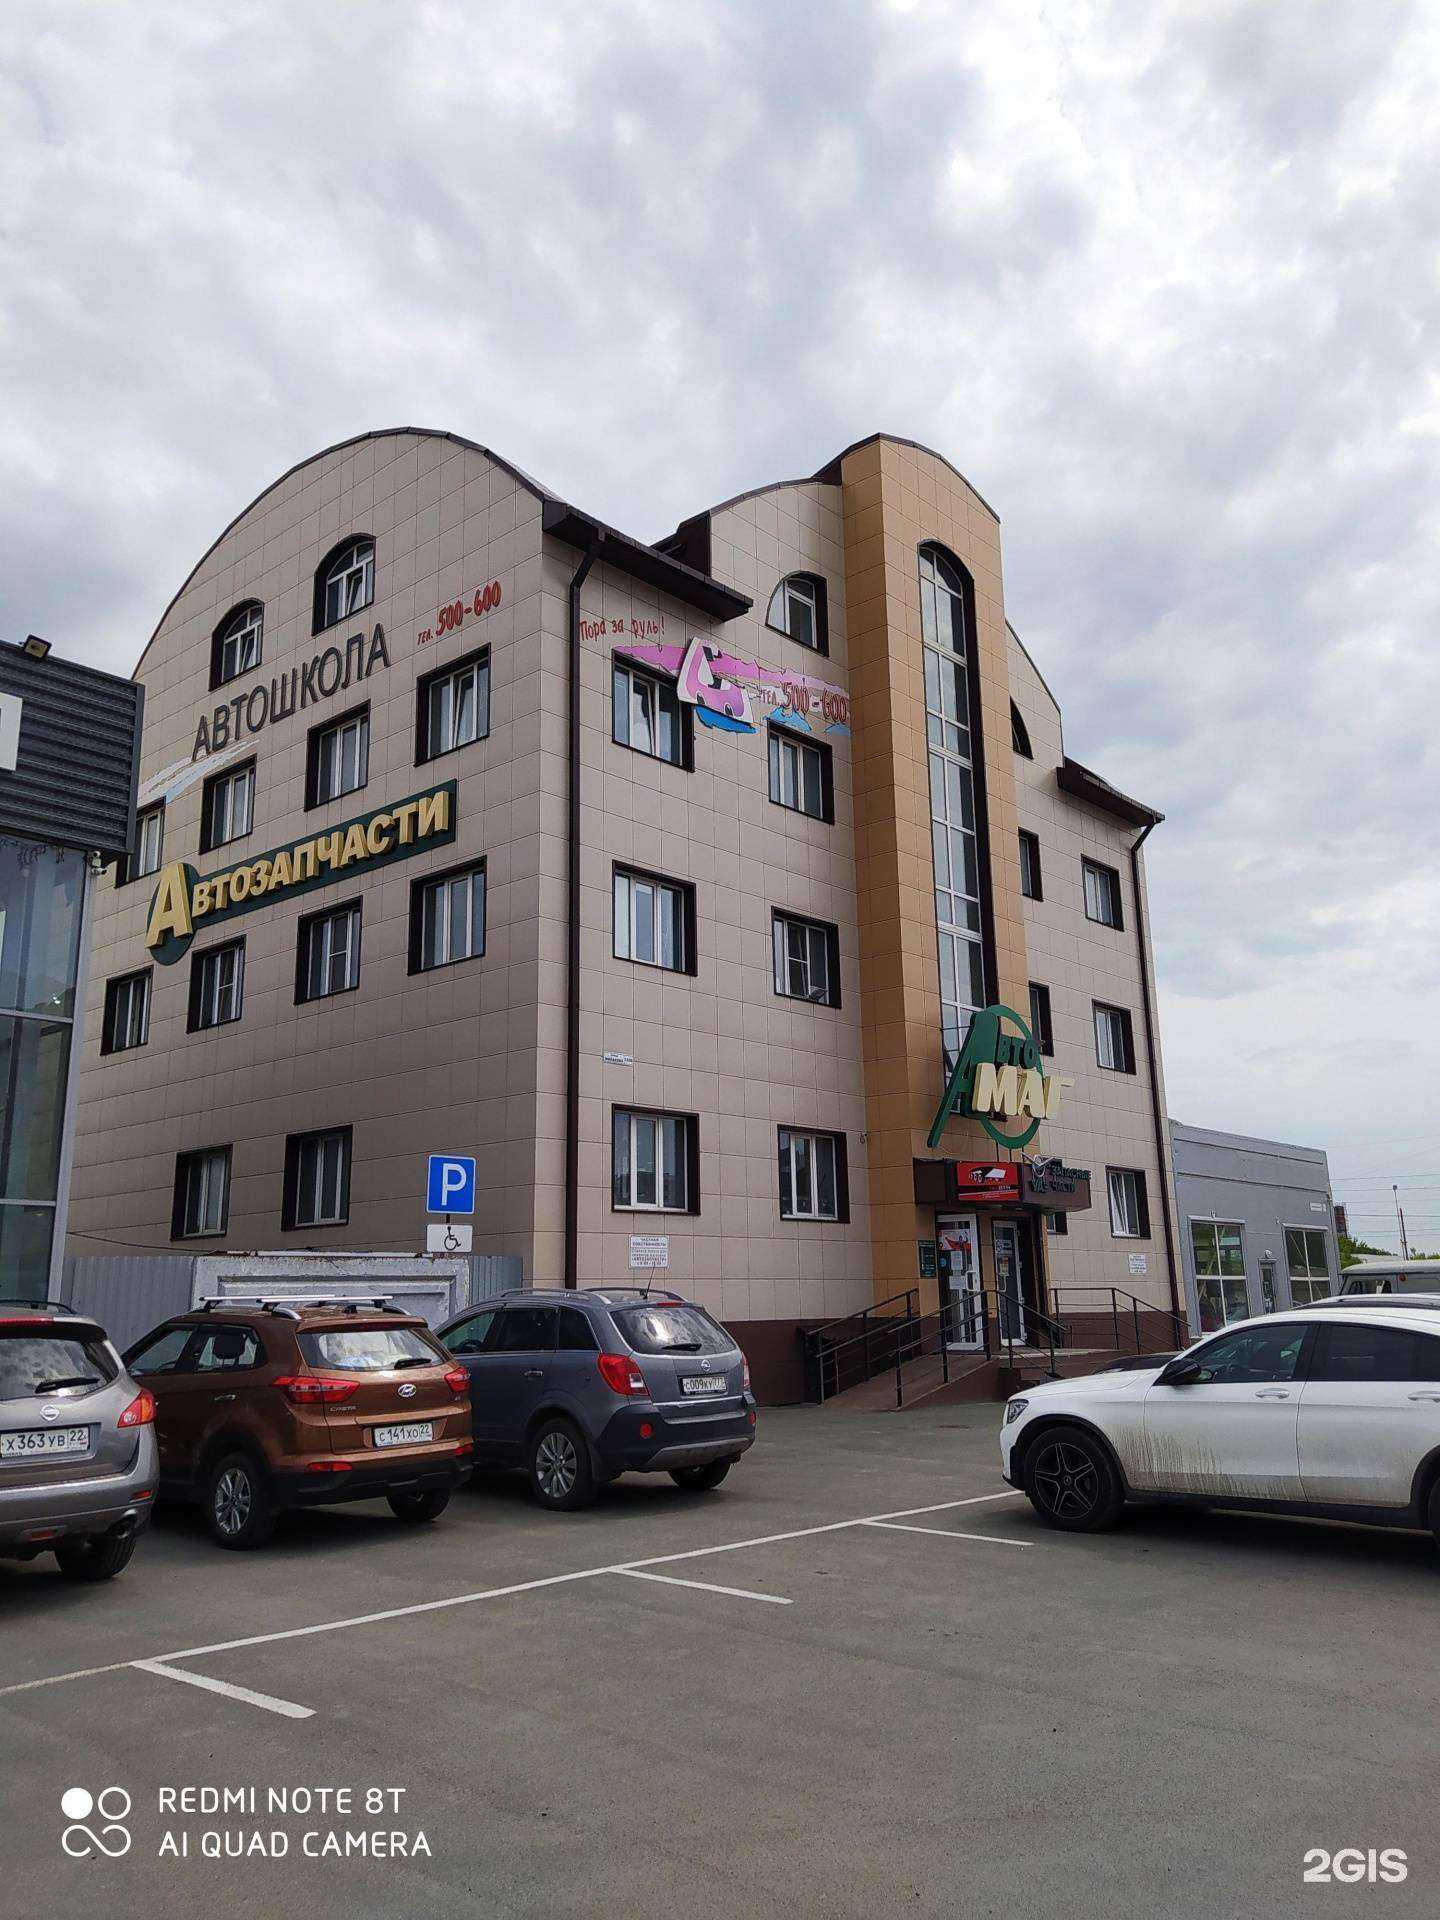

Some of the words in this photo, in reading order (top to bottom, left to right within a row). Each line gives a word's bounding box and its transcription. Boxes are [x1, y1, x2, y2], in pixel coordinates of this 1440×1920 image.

[436, 580, 501, 637] 500-600
[579, 619, 606, 642] Пора
[611, 618, 625, 634] за
[631, 616, 666, 639] руль!
[191, 622, 391, 763] АВТОШКОЛА
[972, 1062, 1076, 1120] МАГ
[441, 1163, 467, 1206] P
[69, 1429, 85, 1443] 22
